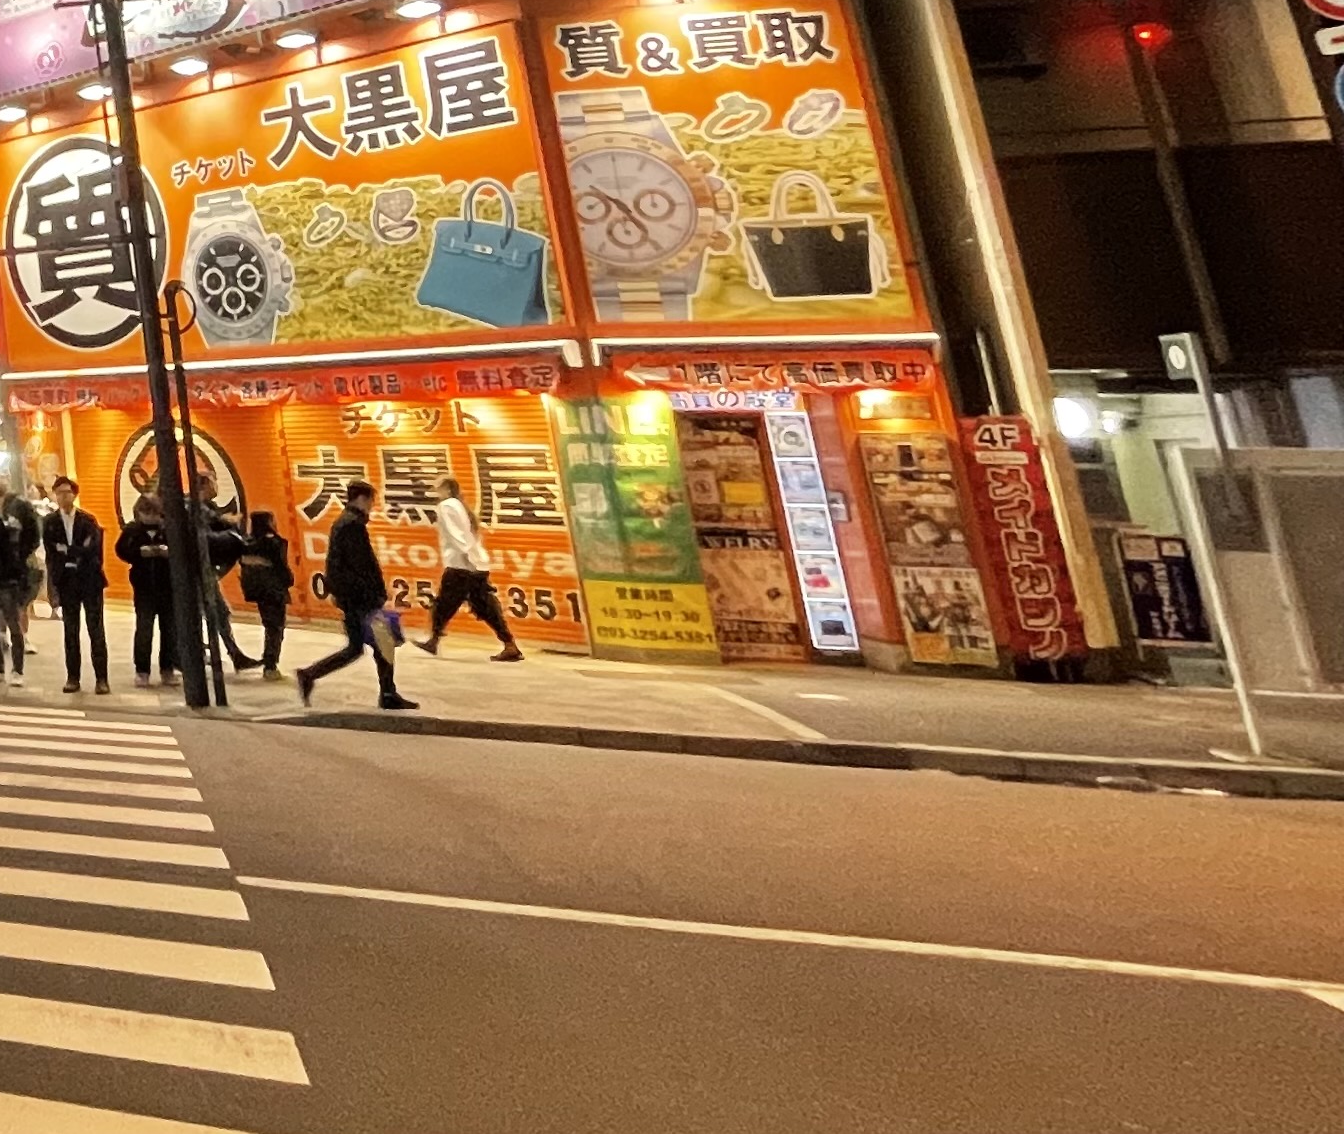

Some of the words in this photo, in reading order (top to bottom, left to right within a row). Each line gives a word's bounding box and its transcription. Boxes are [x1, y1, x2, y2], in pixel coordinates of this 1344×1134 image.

[260, 35, 524, 173] 大黒屋
[172, 147, 256, 189] チケット
[456, 364, 556, 394] 無料査定
[340, 400, 482, 435] チケット
[977, 426, 1018, 448] 4F
[296, 446, 567, 528] 大黒屋
[303, 530, 578, 578] Dkouya
